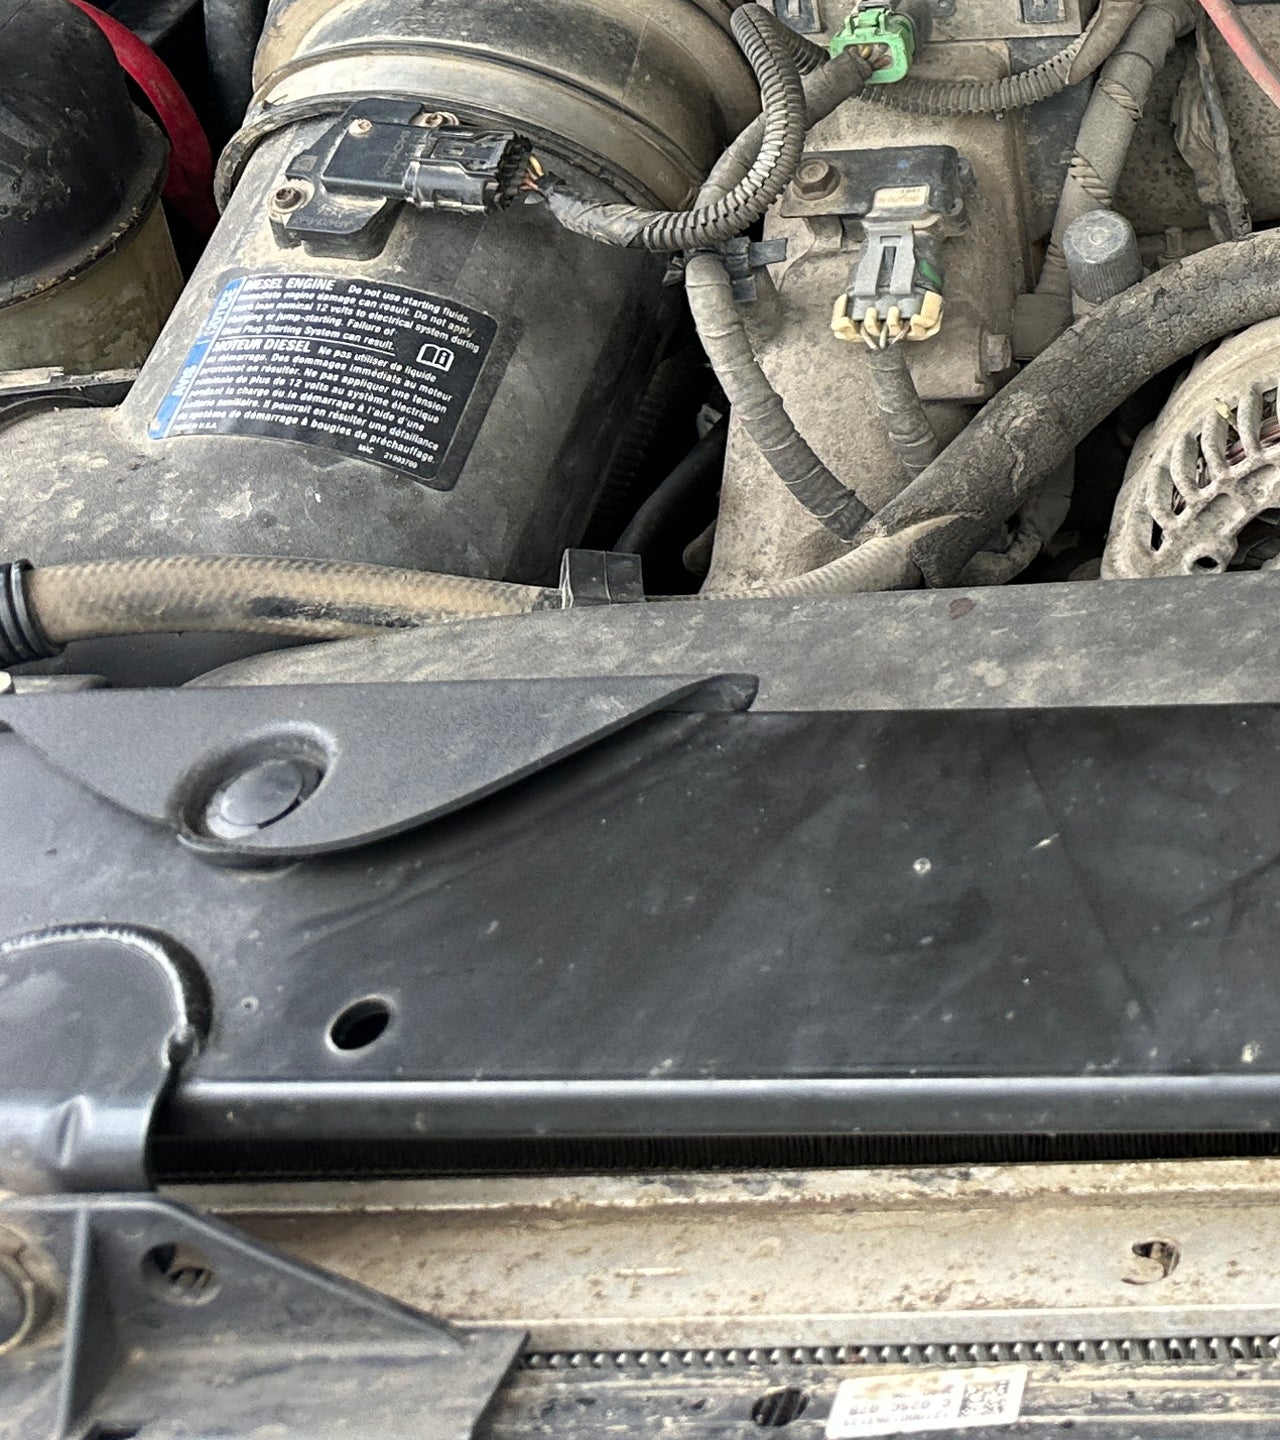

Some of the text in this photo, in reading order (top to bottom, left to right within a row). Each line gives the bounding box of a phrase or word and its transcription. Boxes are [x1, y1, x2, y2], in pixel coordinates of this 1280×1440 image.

[245, 278, 470, 324] DIESEL ENGINE Do not use starting fluids.
[283, 291, 315, 300] engine
[316, 292, 355, 304] damage
[358, 298, 377, 308] can
[379, 301, 411, 316] result.
[413, 310, 428, 321] Do
[430, 315, 447, 327] not
[448, 322, 476, 338] apply
[243, 325, 263, 336] Plug
[265, 324, 302, 335] Starting
[303, 326, 340, 338] System
[343, 332, 361, 342] can
[363, 336, 395, 350] result.
[275, 313, 343, 327] jump-starting.
[347, 318, 381, 333] Failure
[383, 326, 396, 336] of
[276, 302, 313, 310] nominal
[316, 303, 329, 312] 12
[330, 304, 353, 315] volts
[356, 307, 367, 317] to
[368, 310, 413, 328] electrical
[415, 322, 449, 340] system
[451, 335, 480, 353] during
[172, 364, 197, 397] AVIS
[212, 339, 437, 383] MOTEUR DIESEL Ne pas utiliser de liquide
[271, 354, 289, 363] Des
[292, 355, 347, 371] dommages
[349, 363, 403, 385] immédiats
[403, 380, 417, 390] au
[418, 383, 453, 402] moteur
[225, 386, 236, 395] la
[236, 387, 269, 397] charge
[272, 389, 285, 397] ou
[287, 390, 298, 399] le
[300, 392, 355, 411] démarrage
[357, 402, 365, 413] à
[398, 416, 425, 432] d'une
[235, 375, 248, 384] de
[248, 375, 270, 385] plus
[273, 377, 286, 386] de
[288, 378, 303, 388] 12
[304, 380, 329, 392] volts
[331, 386, 345, 395] au
[347, 388, 390, 407] système
[391, 400, 440, 424] électrique
[247, 365, 259, 373] en
[260, 364, 302, 375] résulter.
[303, 368, 319, 378] Ne
[319, 372, 340, 382] pas
[341, 375, 391, 394] appliquer
[391, 389, 411, 400] une
[412, 395, 448, 414] tension
[229, 411, 242, 419] de
[243, 411, 299, 425] démarrage
[301, 417, 308, 426] à
[310, 419, 352, 436] bougies
[354, 429, 368, 440] de
[369, 434, 435, 464] préchauffage.
[271, 401, 311, 414] pourrait
[313, 408, 327, 417] en
[328, 410, 367, 426] résulter
[368, 421, 388, 432] une
[389, 426, 440, 451] défaillance
[358, 444, 375, 455] MAC
